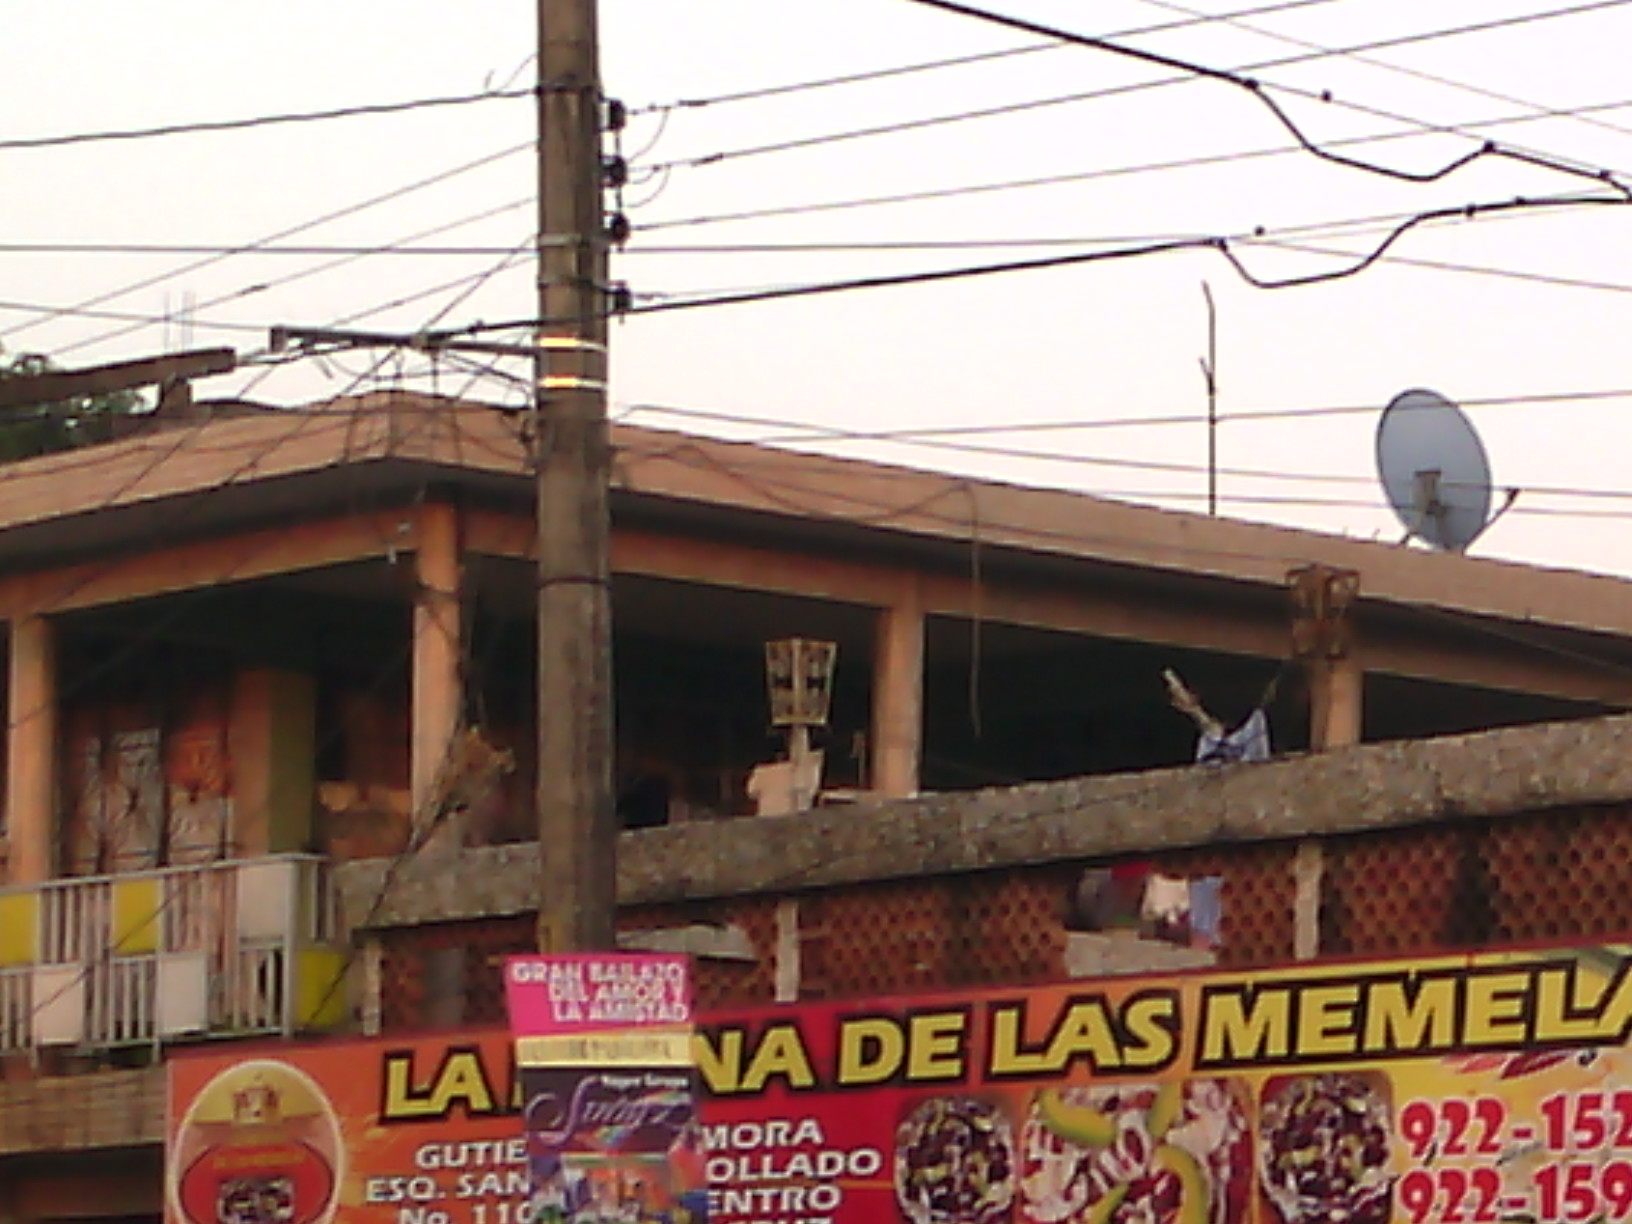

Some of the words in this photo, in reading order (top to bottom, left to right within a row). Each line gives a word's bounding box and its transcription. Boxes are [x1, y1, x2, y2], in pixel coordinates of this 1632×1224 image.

[385, 1052, 493, 1118] LA
[838, 1012, 966, 1085] DE
[989, 998, 1175, 1075] LAS
[415, 1139, 529, 1169] GUTIE
[702, 1119, 824, 1150] MORA
[366, 1176, 446, 1202] ESQ.
[456, 1171, 530, 1198] SAN
[706, 1148, 882, 1184] OLLADO
[708, 1184, 841, 1216] ENTRO
